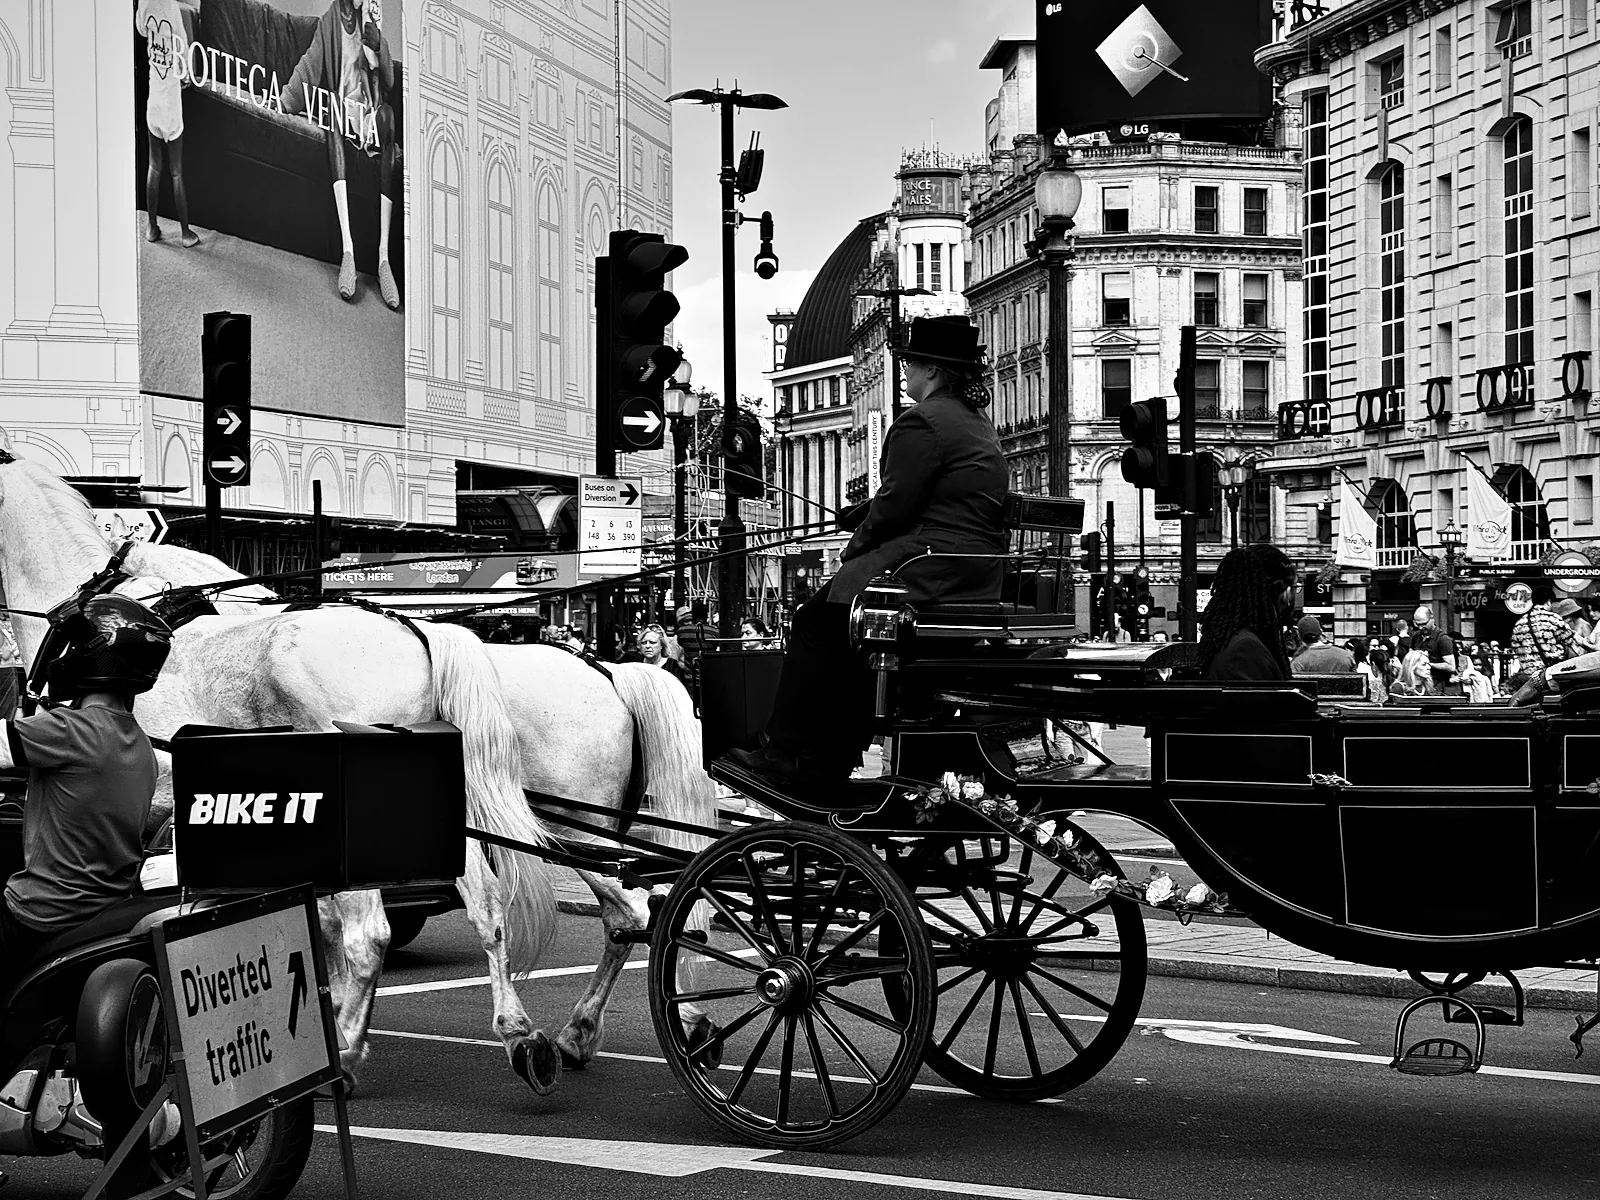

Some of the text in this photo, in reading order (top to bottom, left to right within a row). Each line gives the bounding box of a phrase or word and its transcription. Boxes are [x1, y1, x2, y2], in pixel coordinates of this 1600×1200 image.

[1053, 3, 1062, 12] LG
[172, 33, 286, 115] BOTTEGA
[302, 81, 381, 148] VENETA
[1134, 124, 1149, 135] LG
[584, 483, 605, 491] Buses
[584, 493, 617, 502] Diversion
[609, 520, 614, 528] 6
[625, 520, 633, 528] 13
[588, 532, 636, 541] 148 36 390
[324, 573, 394, 581] TICKETS HERE
[1544, 568, 1600, 576] UNDERGROUND
[426, 572, 459, 583] London
[1465, 591, 1488, 609] Cafe
[188, 792, 324, 824] BIKE IT
[180, 944, 272, 1018] Diverted
[206, 1020, 273, 1086] traffic
